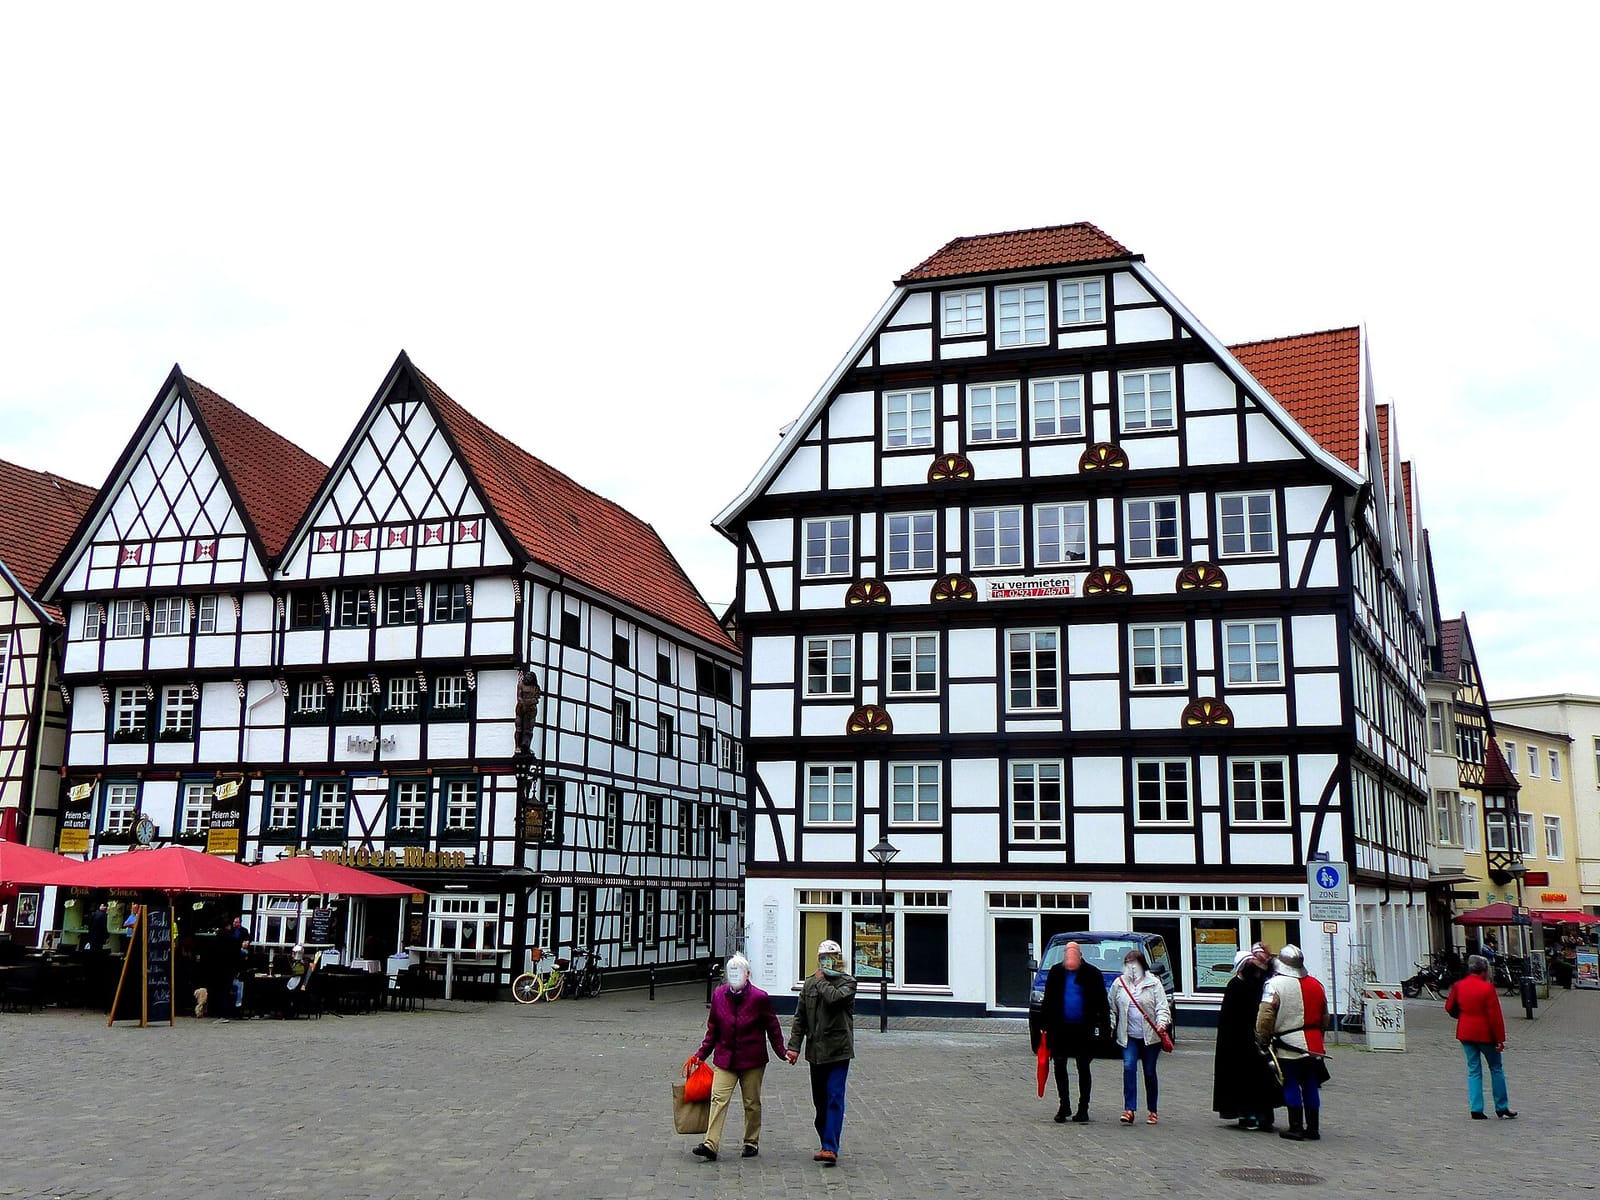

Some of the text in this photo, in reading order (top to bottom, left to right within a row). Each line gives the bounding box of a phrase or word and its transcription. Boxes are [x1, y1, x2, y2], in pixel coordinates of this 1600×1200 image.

[991, 578, 1070, 590] zu vermieten
[993, 590, 1008, 598] Tel.
[65, 811, 82, 819] Feiern
[211, 810, 240, 819] Feiern Sie
[63, 820, 87, 828] mit uns!
[210, 819, 235, 828] mit uns!
[402, 846, 466, 869] Mann
[1319, 891, 1340, 899] ZONE
